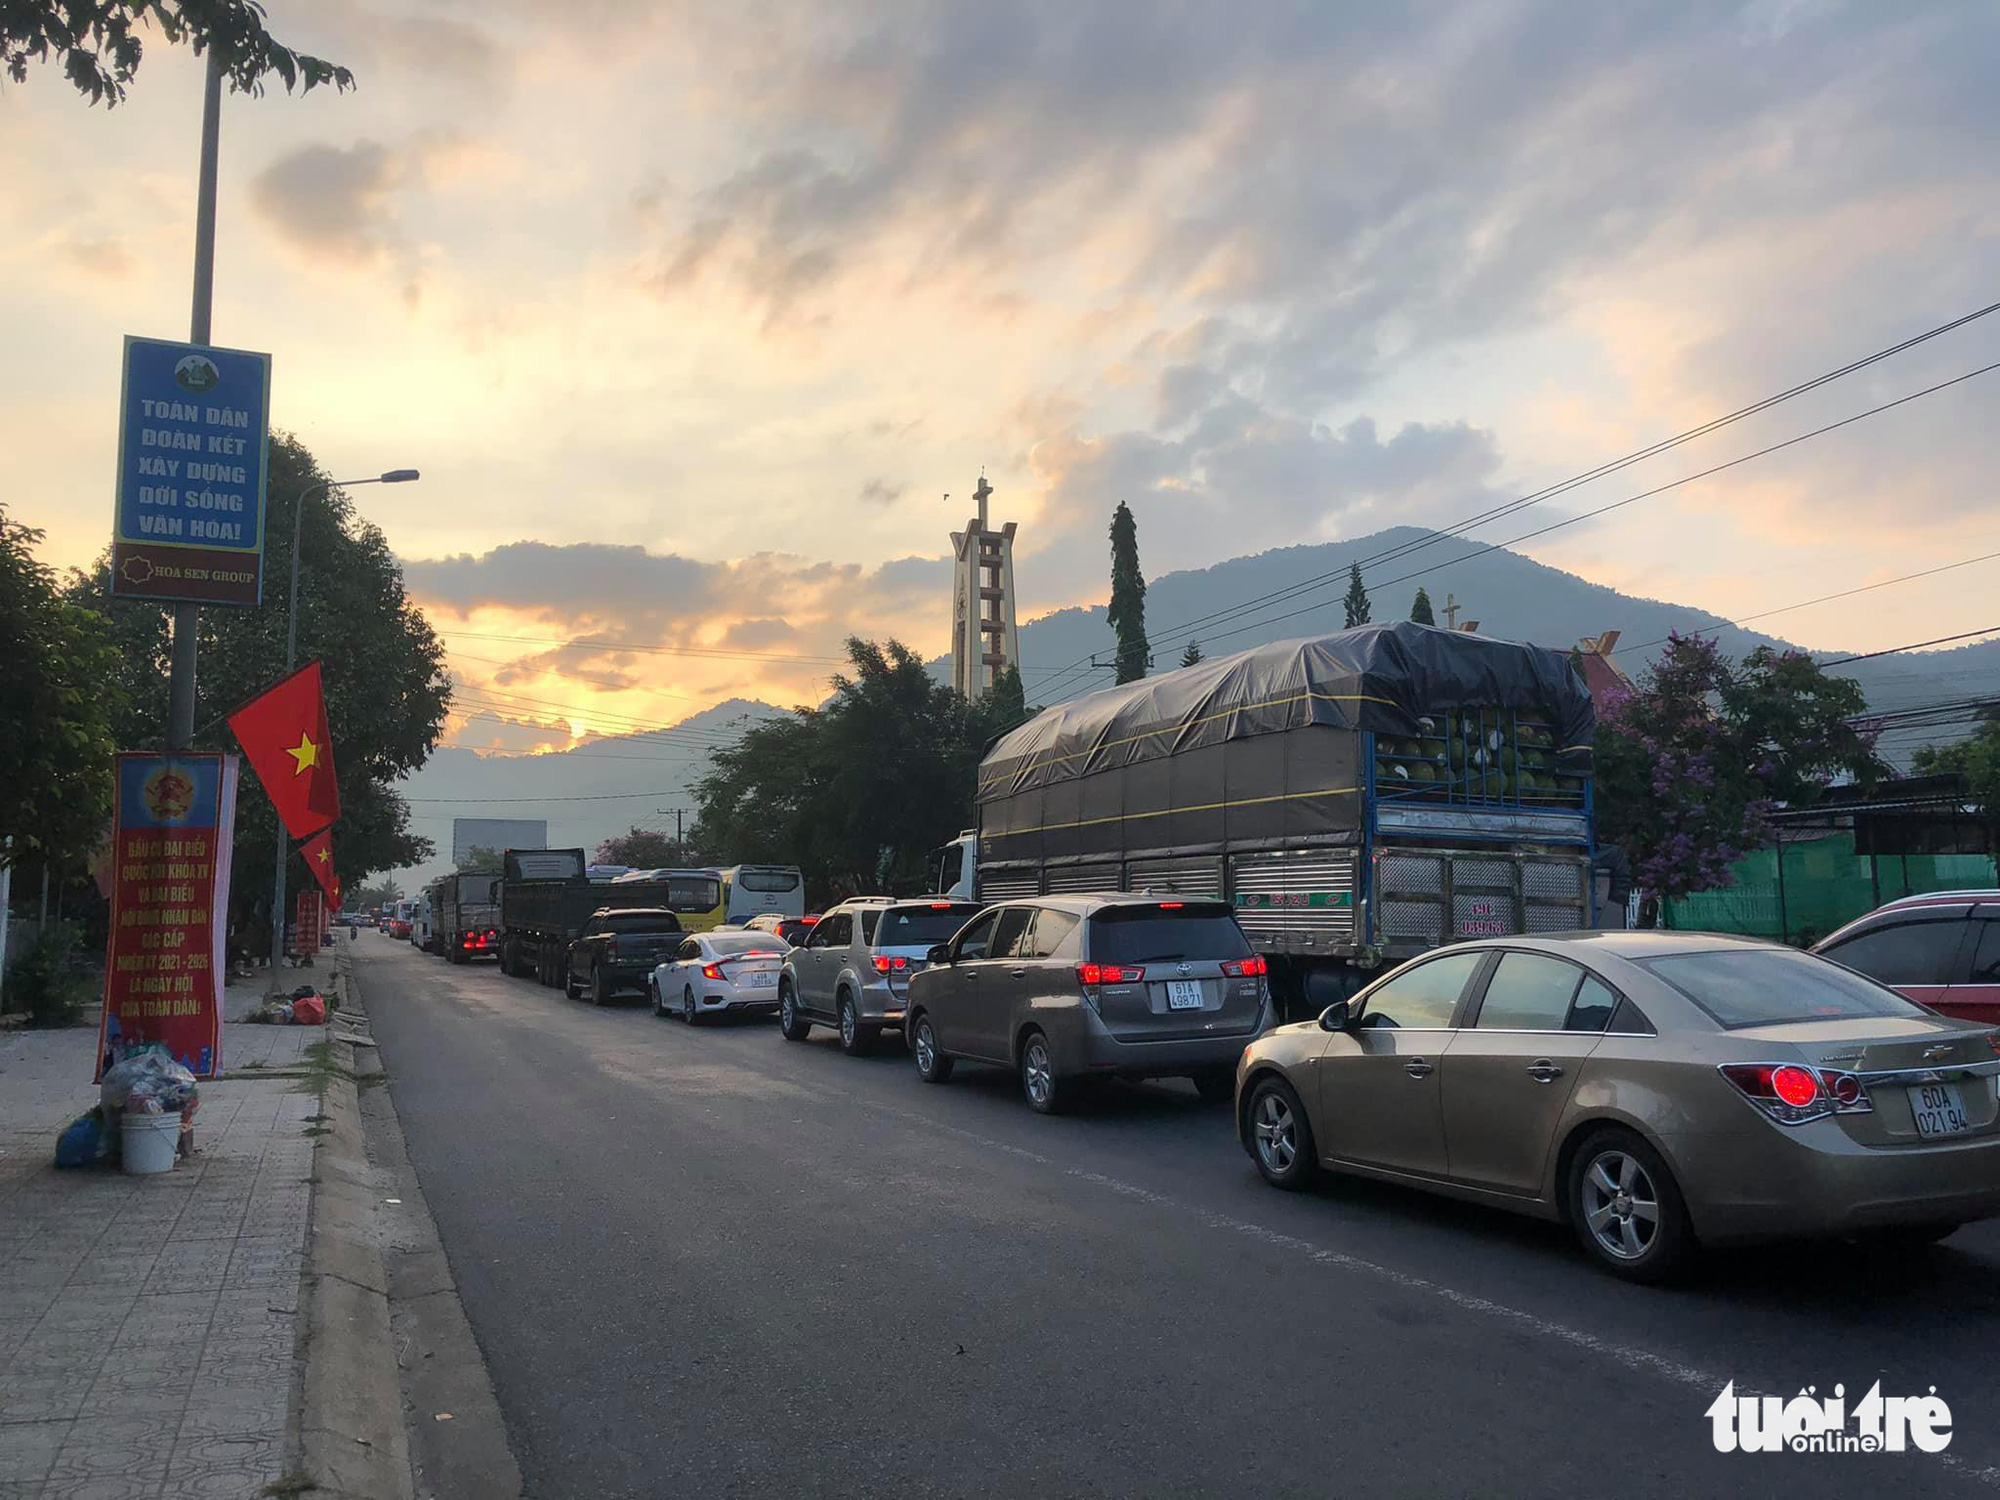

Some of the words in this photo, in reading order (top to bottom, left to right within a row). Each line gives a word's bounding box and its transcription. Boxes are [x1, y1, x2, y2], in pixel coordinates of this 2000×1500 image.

[141, 399, 198, 422] TOÀN
[206, 406, 248, 428] DÂN
[142, 428, 200, 451] ĐOÀN
[208, 432, 247, 456] KẾT
[138, 456, 180, 478] XÂY
[186, 461, 246, 484] DỰNG
[139, 485, 177, 507] ĐỜI
[185, 487, 243, 512] SỐNG
[139, 515, 183, 536] VĂN
[190, 519, 242, 540] HÓA!
[154, 565, 181, 578] HOA
[184, 568, 209, 581] SEN
[212, 570, 254, 583] GROUP
[168, 861, 196, 880] KHÓA
[171, 881, 195, 902] BIỂU
[162, 905, 189, 925] NHÂN
[163, 928, 186, 948] CẤP
[158, 953, 180, 970] 2021
[175, 973, 193, 996] HỘI
[142, 996, 172, 1016] TOÀN
[1921, 1086, 1952, 1109] 60A
[1917, 1108, 1969, 1134] 021.94
